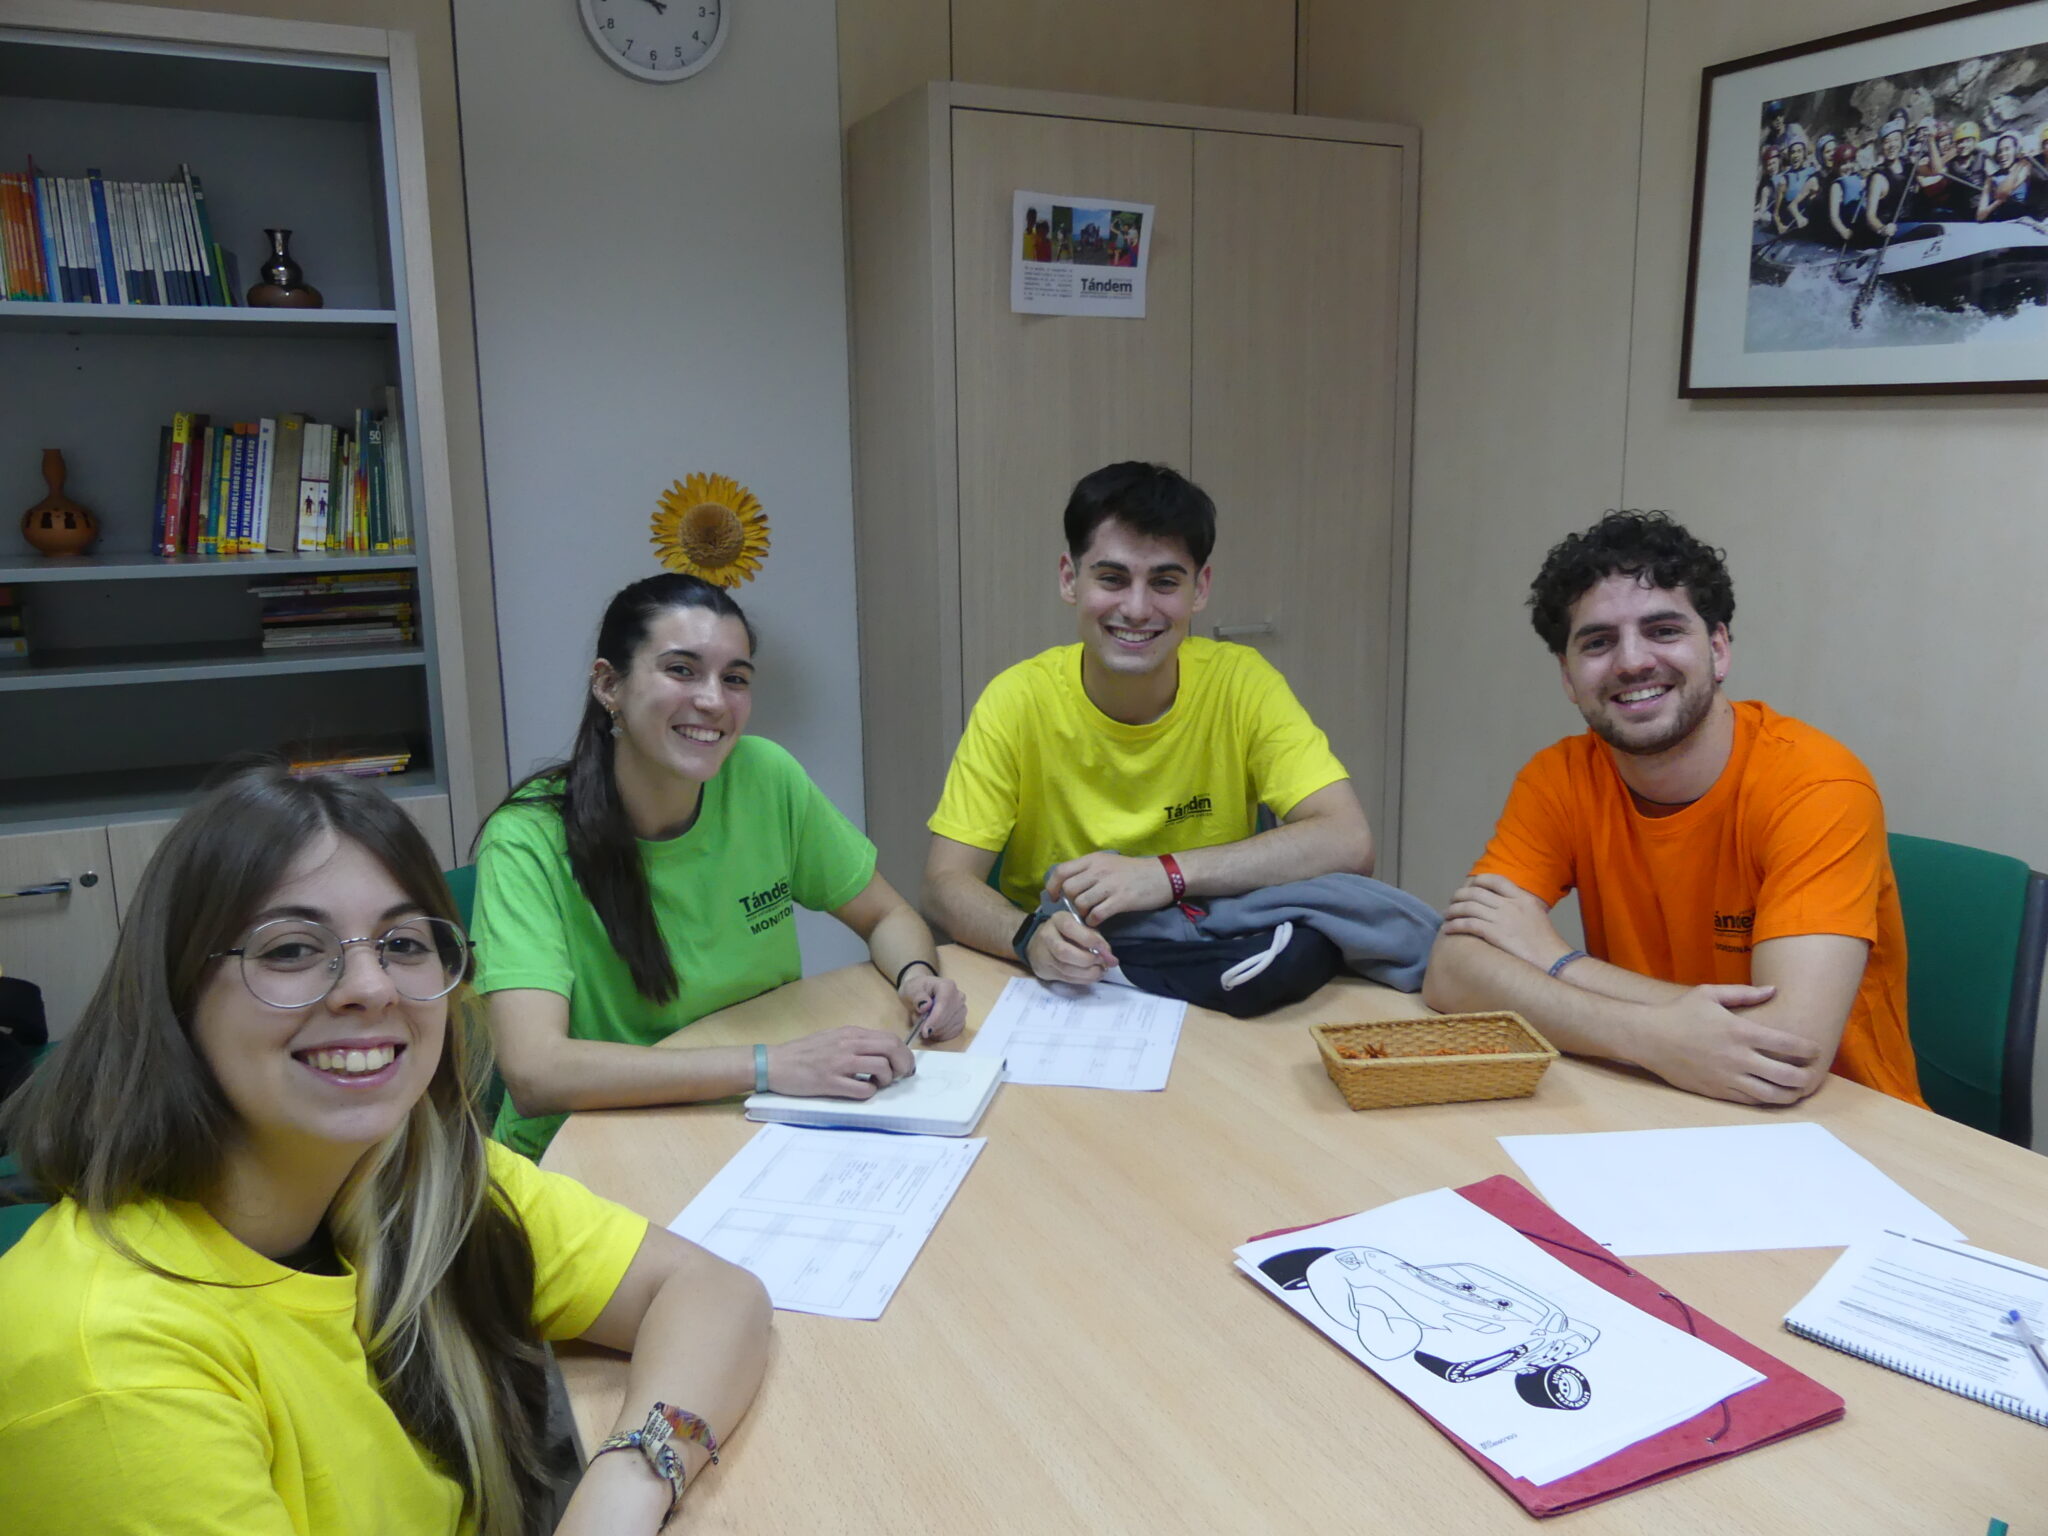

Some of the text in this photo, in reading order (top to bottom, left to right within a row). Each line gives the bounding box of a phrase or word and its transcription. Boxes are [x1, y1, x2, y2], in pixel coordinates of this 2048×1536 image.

[698, 7, 706, 18] 3
[607, 18, 615, 29] 8
[692, 30, 699, 41] 4
[626, 39, 634, 51] 7
[650, 50, 657, 61] 6
[674, 47, 682, 58] 5
[1081, 278, 1133, 292] Tándem
[369, 430, 381, 440] 50
[1164, 796, 1211, 819] Tándm
[739, 882, 790, 913] Tánde
